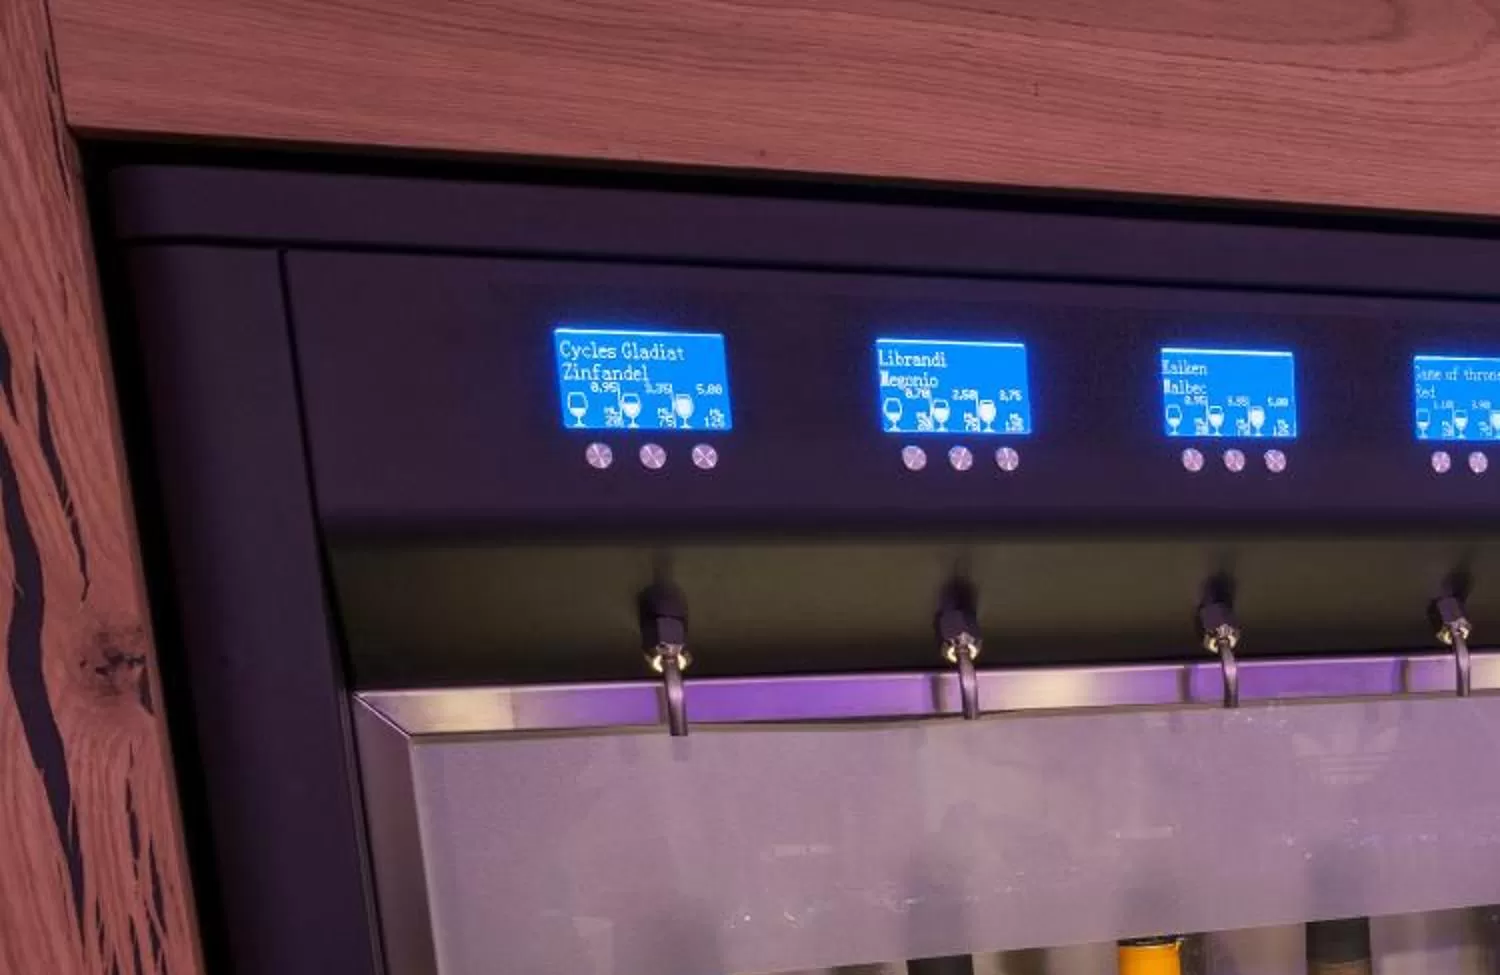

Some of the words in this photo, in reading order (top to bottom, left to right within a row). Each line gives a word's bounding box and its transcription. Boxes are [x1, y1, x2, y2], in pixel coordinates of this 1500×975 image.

[559, 339, 617, 361] Cycles
[621, 341, 686, 361] Gladiat
[879, 349, 948, 369] Librandi
[562, 361, 650, 382] Zinfandel
